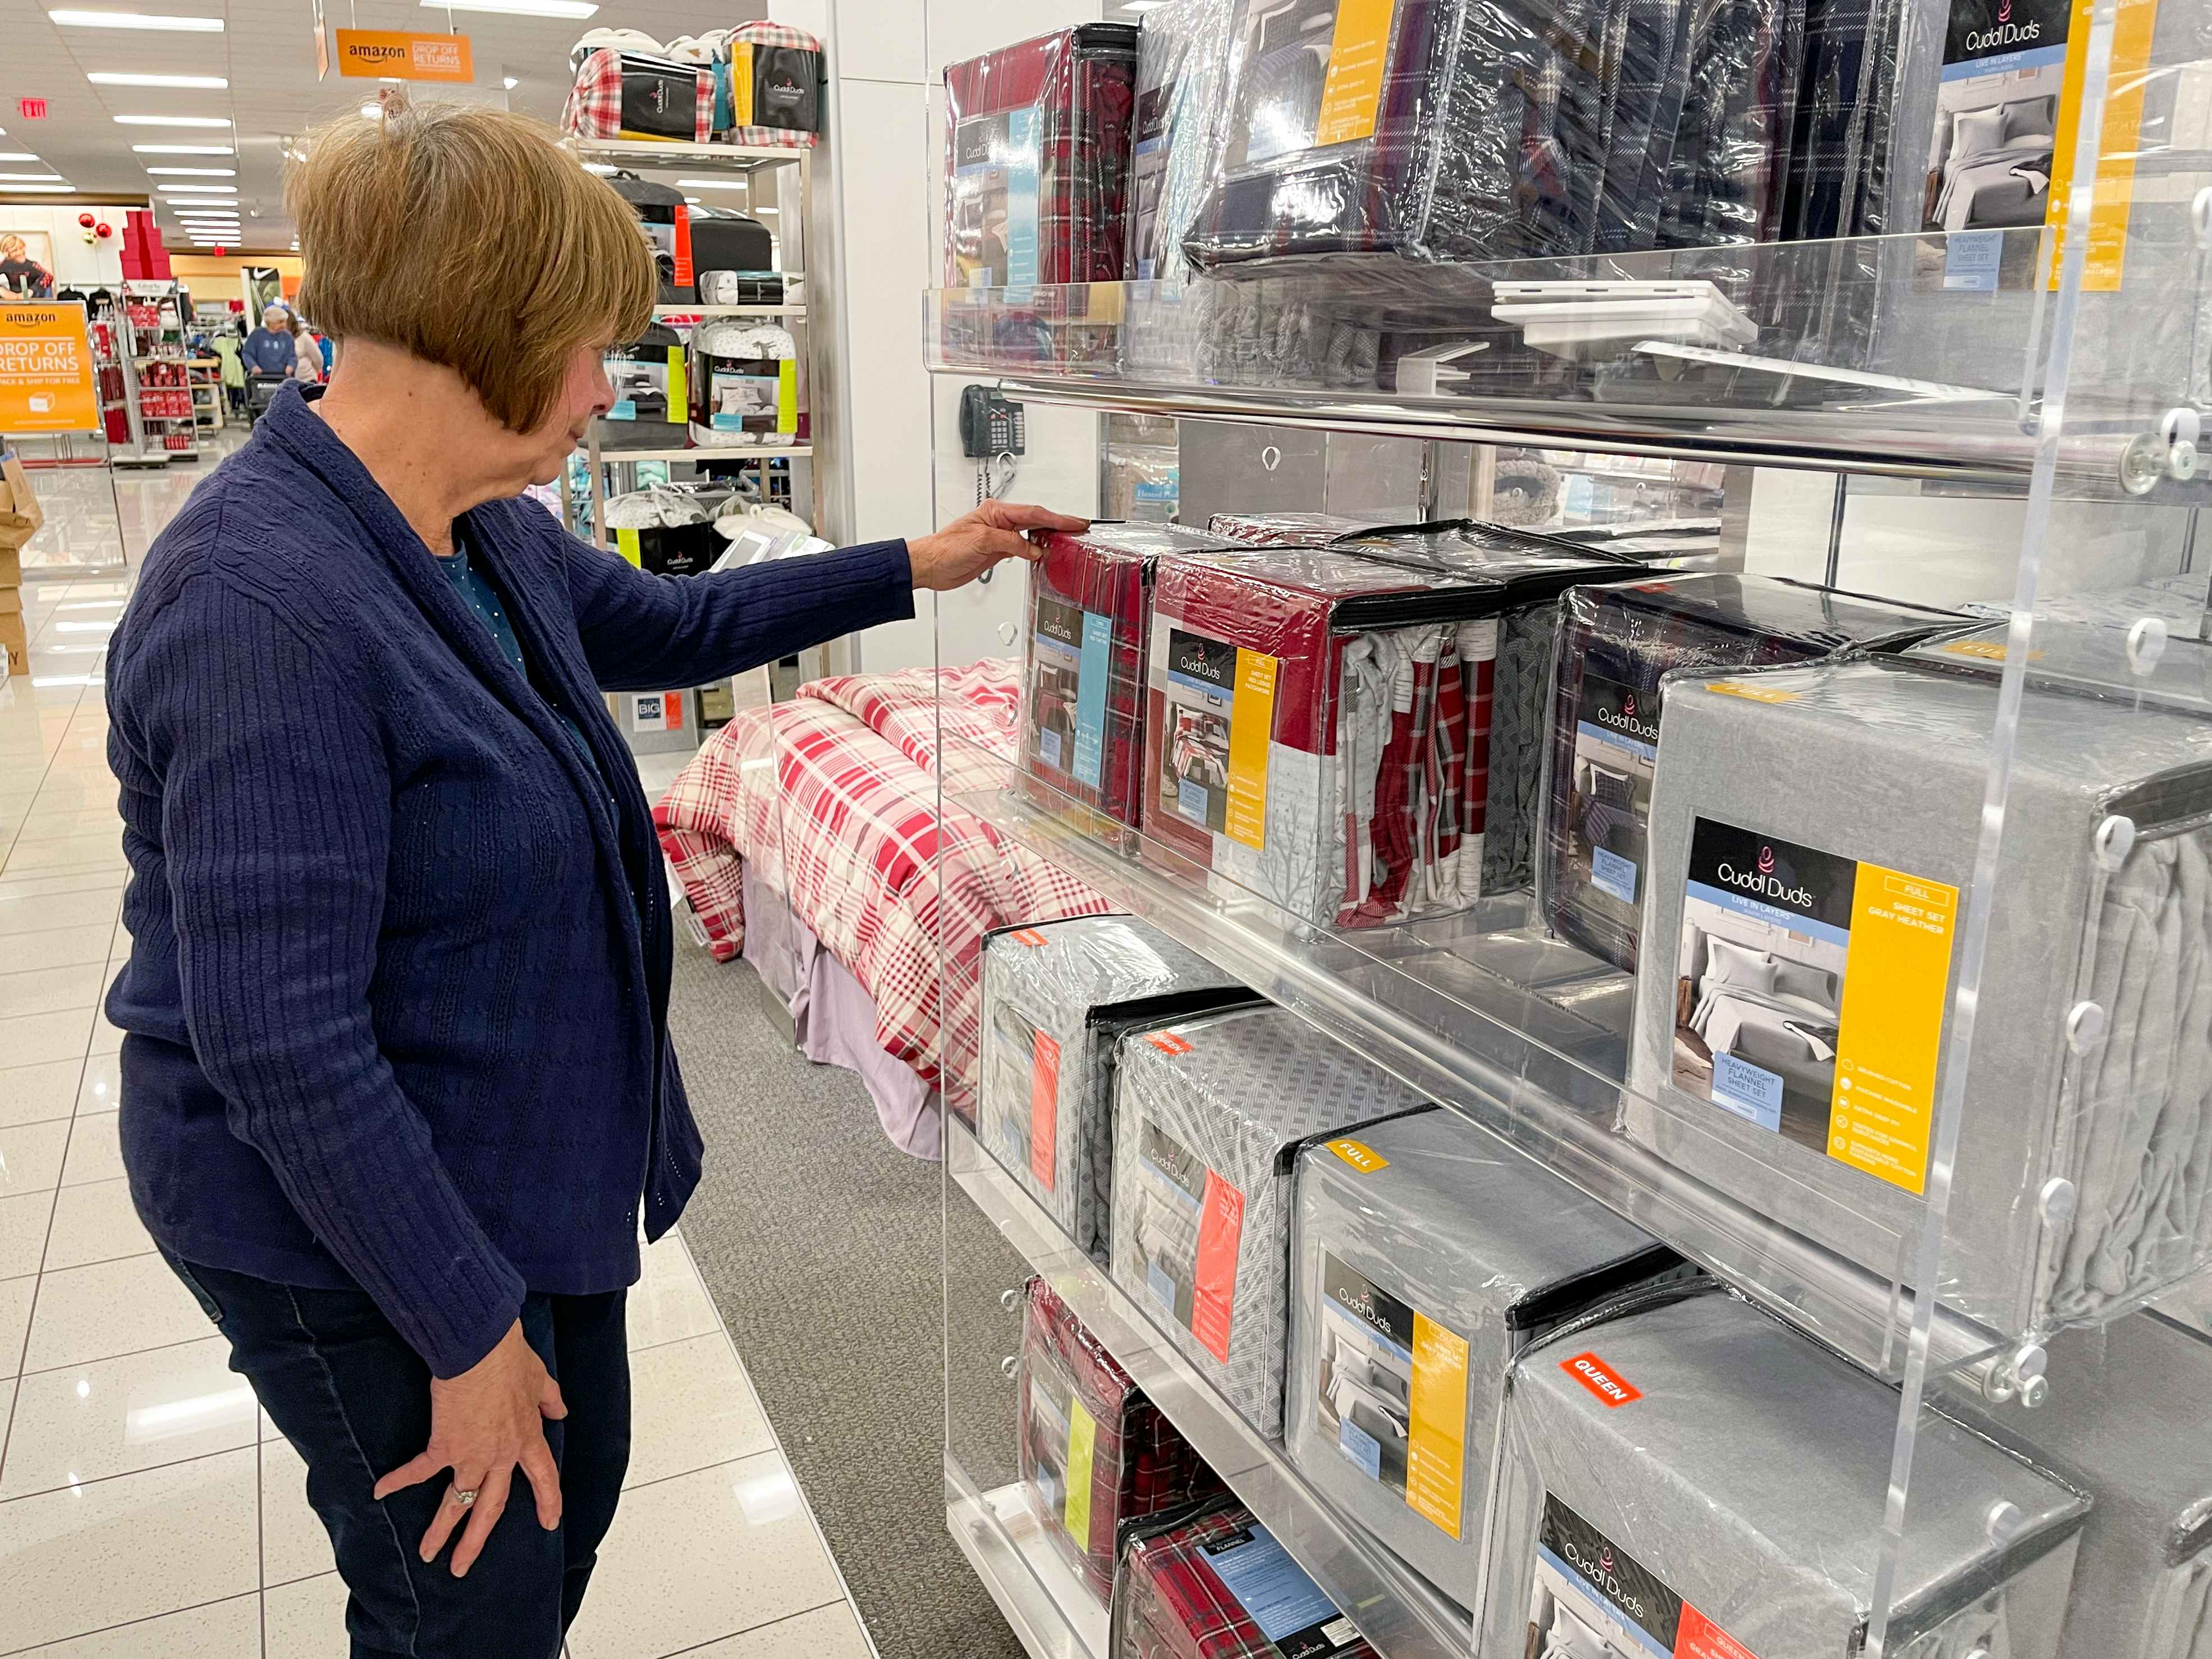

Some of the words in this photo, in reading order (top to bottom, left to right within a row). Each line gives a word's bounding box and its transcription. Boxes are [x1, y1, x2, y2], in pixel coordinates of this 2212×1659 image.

[1966, 26, 2004, 51] Cuddl
[2004, 20, 2040, 44] Duds
[350, 45, 405, 58] amazon
[413, 44, 438, 54] DROP
[441, 45, 458, 55] OFF
[413, 54, 460, 65] RETURNS
[1976, 58, 1989, 68] LIVE
[6, 313, 56, 322] amazon
[44, 342, 76, 356] OFF
[1044, 620, 1058, 634] Cuddl
[1058, 625, 1071, 639] Duds
[1181, 657, 1201, 673] Cuddl
[1202, 663, 1220, 680] Duds
[1598, 707, 1629, 729] Cuddl
[1629, 718, 1659, 740] Duds
[1718, 863, 1766, 893] Cuddl
[1767, 877, 1812, 907] Duds
[1904, 885, 1929, 899] FULL
[1732, 895, 1748, 907] LIVE
[1750, 901, 1758, 910] IN
[1893, 901, 1925, 916] SHEET
[1926, 911, 1946, 923] SET
[1868, 906, 1895, 920] GRAY
[1897, 914, 1944, 934] HEATHER
[1721, 1057, 1775, 1085] HEAVYWEIGHT
[1729, 1067, 1767, 1091] FLANNEL
[1728, 1077, 1750, 1091] SHEET
[1752, 1087, 1766, 1098] SET
[1339, 1143, 1371, 1167] FULL
[1151, 1148, 1171, 1172] Cuddl
[1171, 1164, 1190, 1187] Duds
[1339, 1287, 1365, 1315] Cuddl
[1366, 1305, 1391, 1332] Duds
[1575, 1360, 1627, 1400] QUEEN
[1216, 1538, 1245, 1551] FLANNEL
[1565, 1543, 1605, 1586] Cuddl
[1606, 1576, 1643, 1617] Duds
[1576, 1575, 1592, 1592] LIVE
